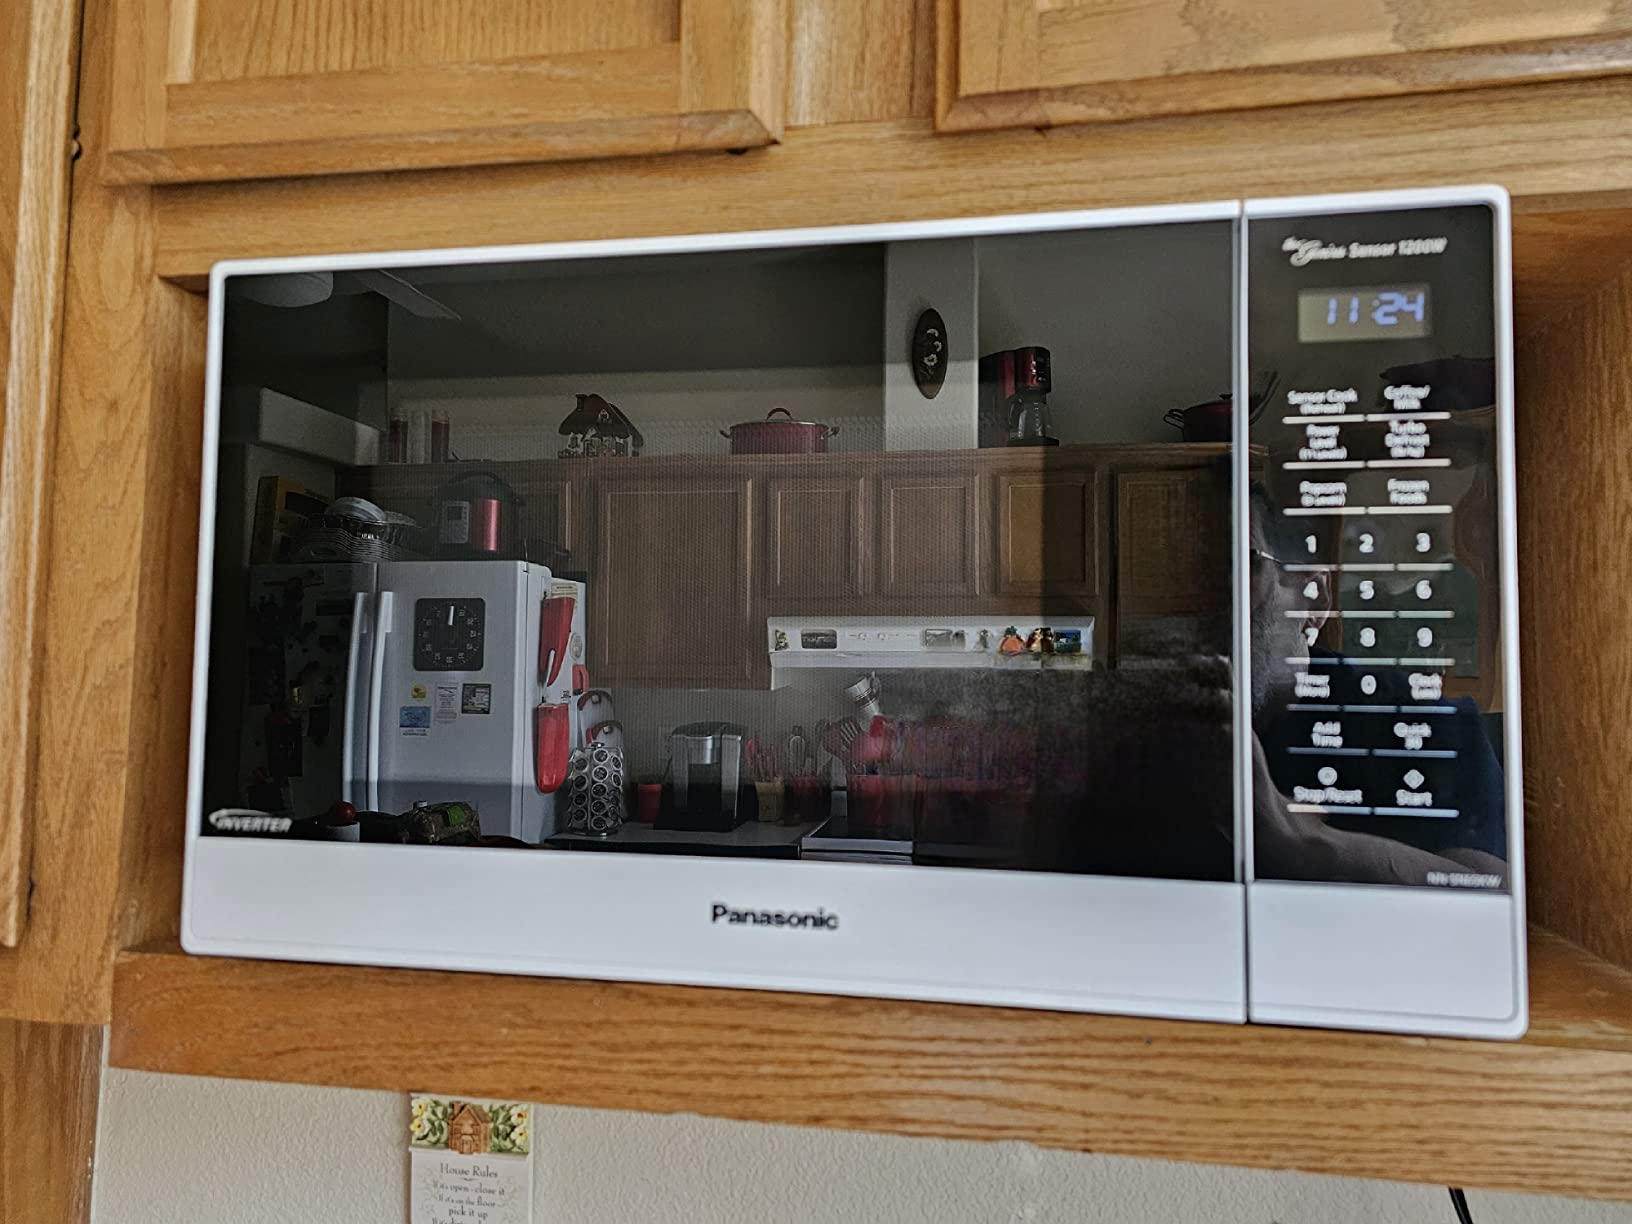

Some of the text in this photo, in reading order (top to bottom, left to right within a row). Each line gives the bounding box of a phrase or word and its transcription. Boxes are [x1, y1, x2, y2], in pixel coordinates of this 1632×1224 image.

[1348, 242, 1397, 258] Sensor
[1327, 292, 1425, 325] 11:24
[1305, 534, 1317, 554] 1
[1359, 533, 1374, 553] 2
[1416, 532, 1431, 553] 3
[1303, 581, 1319, 600] 4
[1359, 580, 1375, 600] 5
[1415, 580, 1432, 600] 6
[1305, 627, 1319, 647] 7
[1360, 627, 1376, 647] 8
[1417, 627, 1433, 648] 9
[1360, 675, 1377, 695] 0
[1395, 789, 1433, 807] Start
[212, 813, 292, 833] INVERTER
[712, 904, 839, 930] Panasonic
[440, 1163, 498, 1178] House Rules
[448, 1204, 466, 1217] pick
[477, 1211, 488, 1221] up
